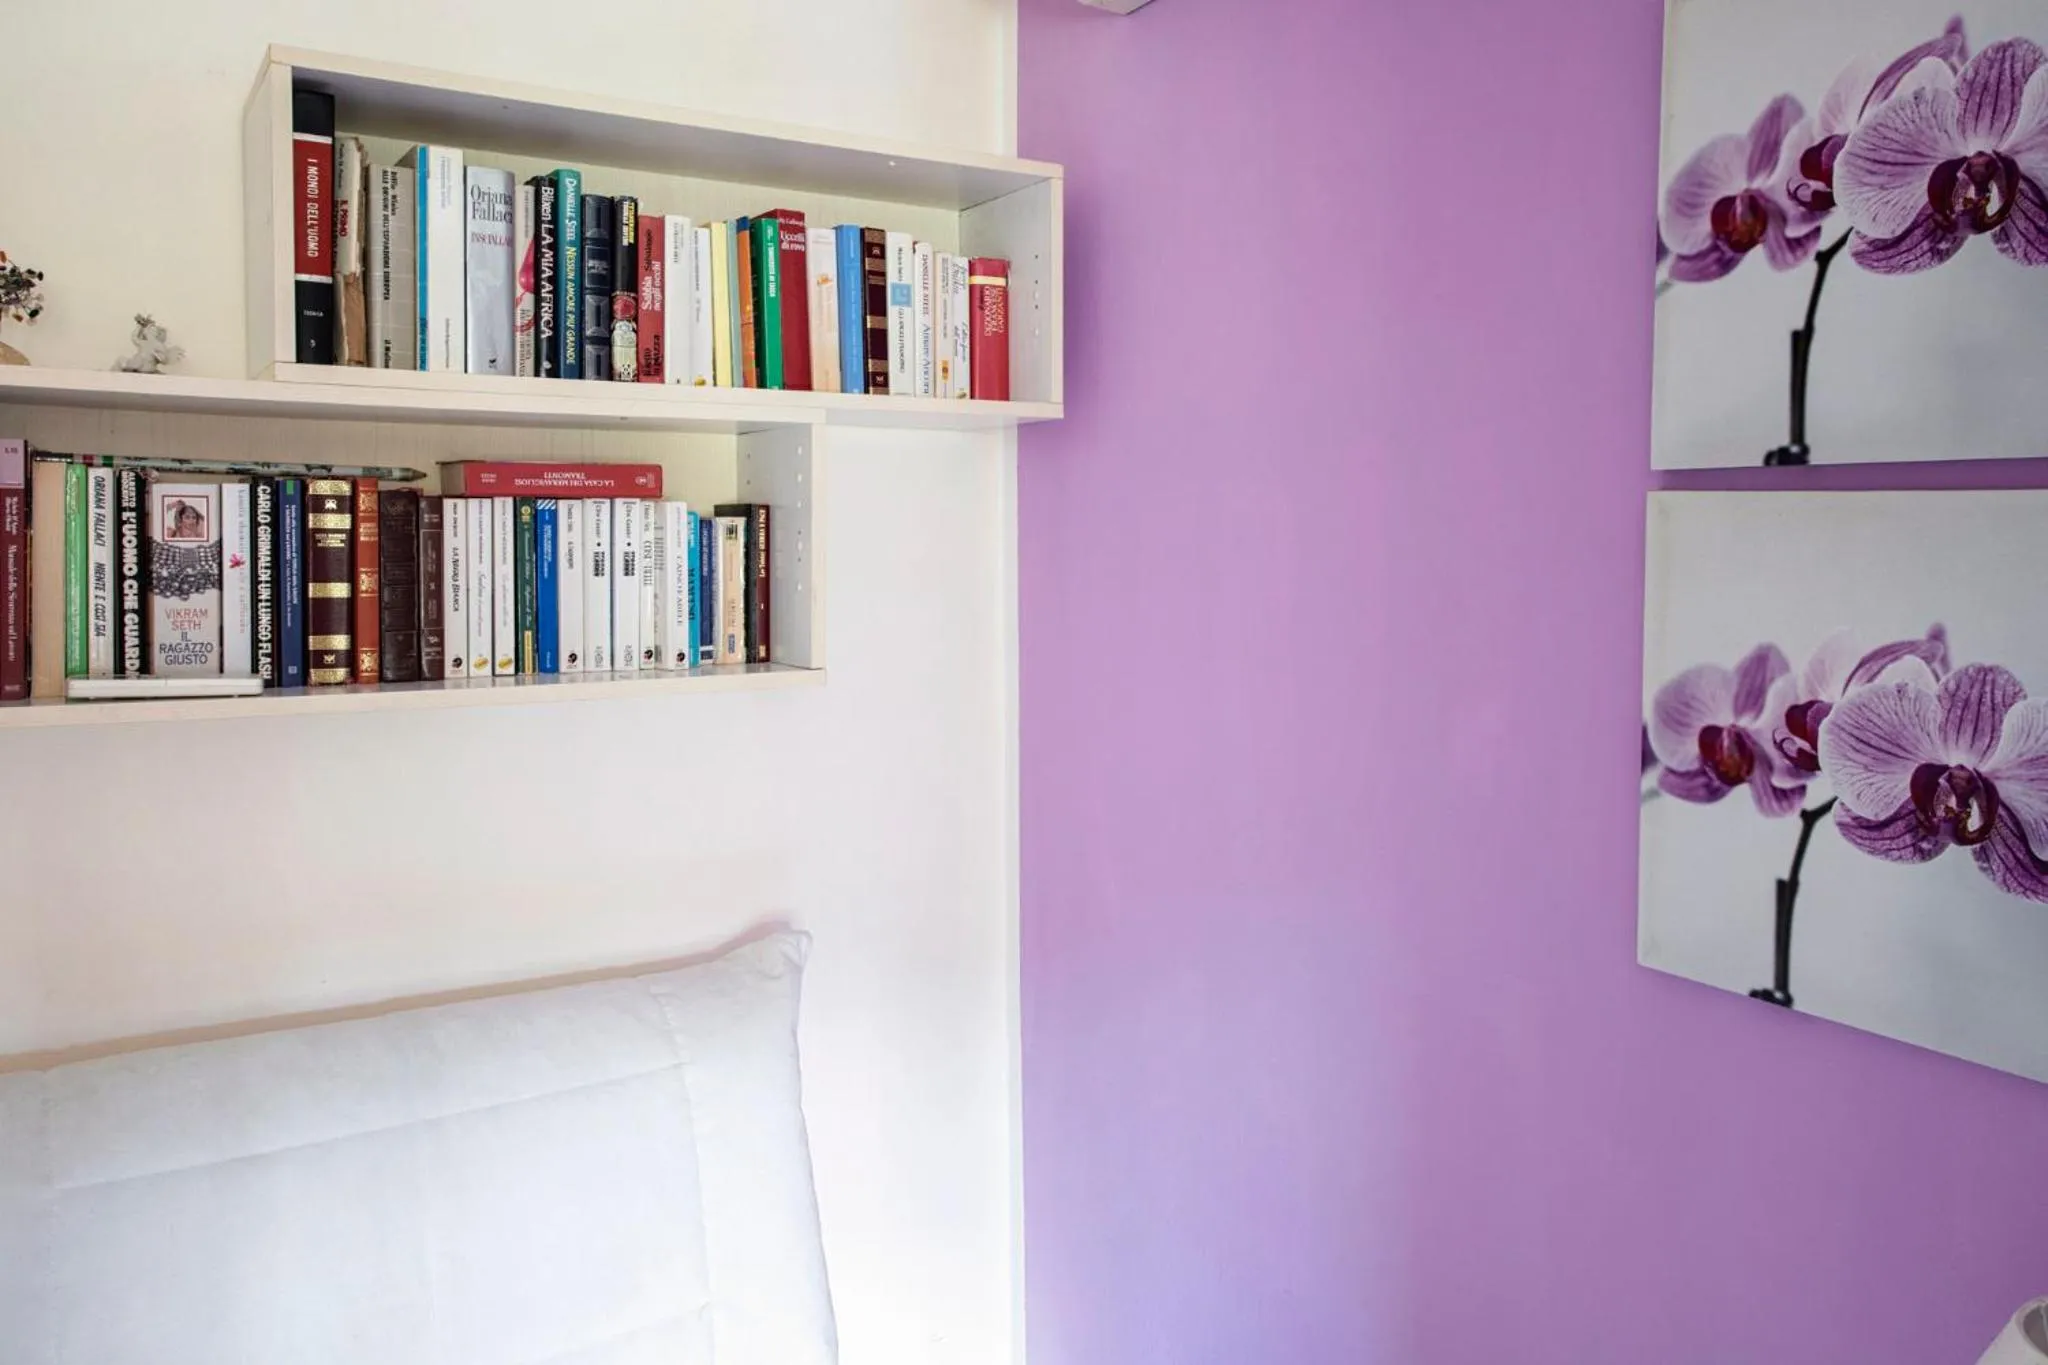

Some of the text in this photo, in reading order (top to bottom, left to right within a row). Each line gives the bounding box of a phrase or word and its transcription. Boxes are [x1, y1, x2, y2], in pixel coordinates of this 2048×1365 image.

[307, 166, 319, 199] MONDI
[307, 203, 319, 259] DELL'UOMO
[541, 186, 554, 338] Blixen LA MIA AFRICA
[641, 276, 653, 310] Sabbia
[94, 476, 107, 509] ORIANA
[129, 471, 137, 508] ALBERTO
[94, 512, 107, 547] FALLACI
[122, 511, 138, 576] L'UOMO
[94, 562, 107, 591] NIENTE
[257, 485, 273, 680] CARLO GRIMALDI UN LUNGO FLASH
[123, 579, 139, 610] CHE
[165, 608, 209, 619] VIKRAM
[171, 620, 202, 631] SETH
[159, 642, 214, 654] RAGAZZO
[181, 631, 192, 642] IL
[165, 654, 209, 666] GIUSTO
